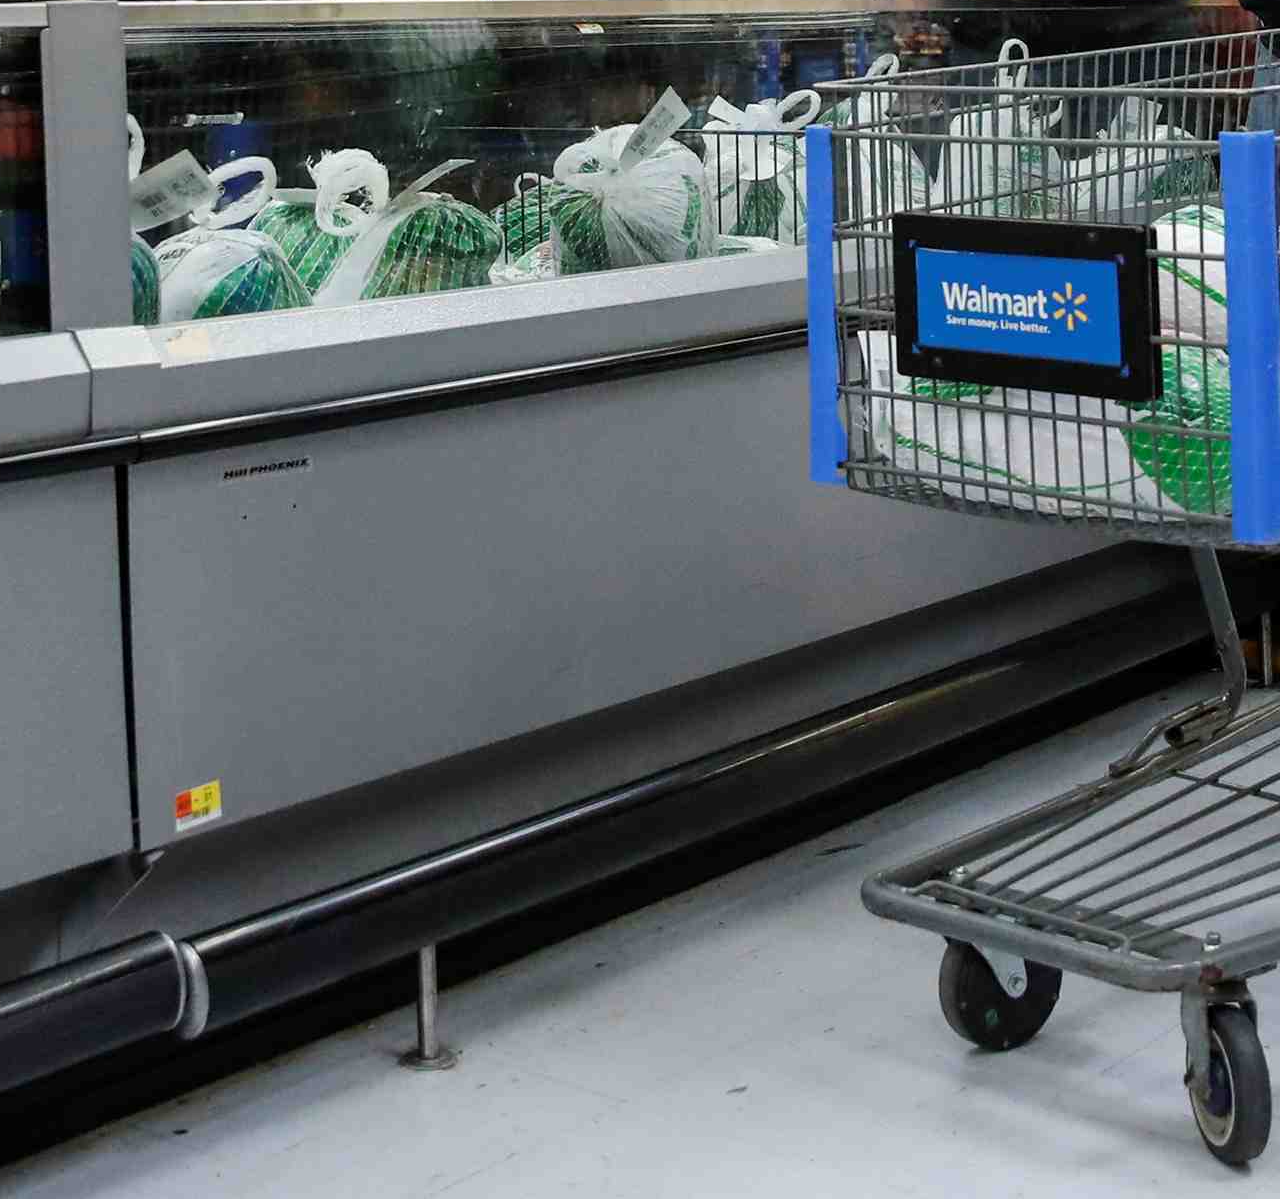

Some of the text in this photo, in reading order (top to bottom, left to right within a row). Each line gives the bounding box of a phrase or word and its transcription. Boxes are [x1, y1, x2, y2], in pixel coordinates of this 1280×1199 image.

[942, 281, 1049, 320] Walmart
[946, 314, 1051, 334] Save money. Live better.
